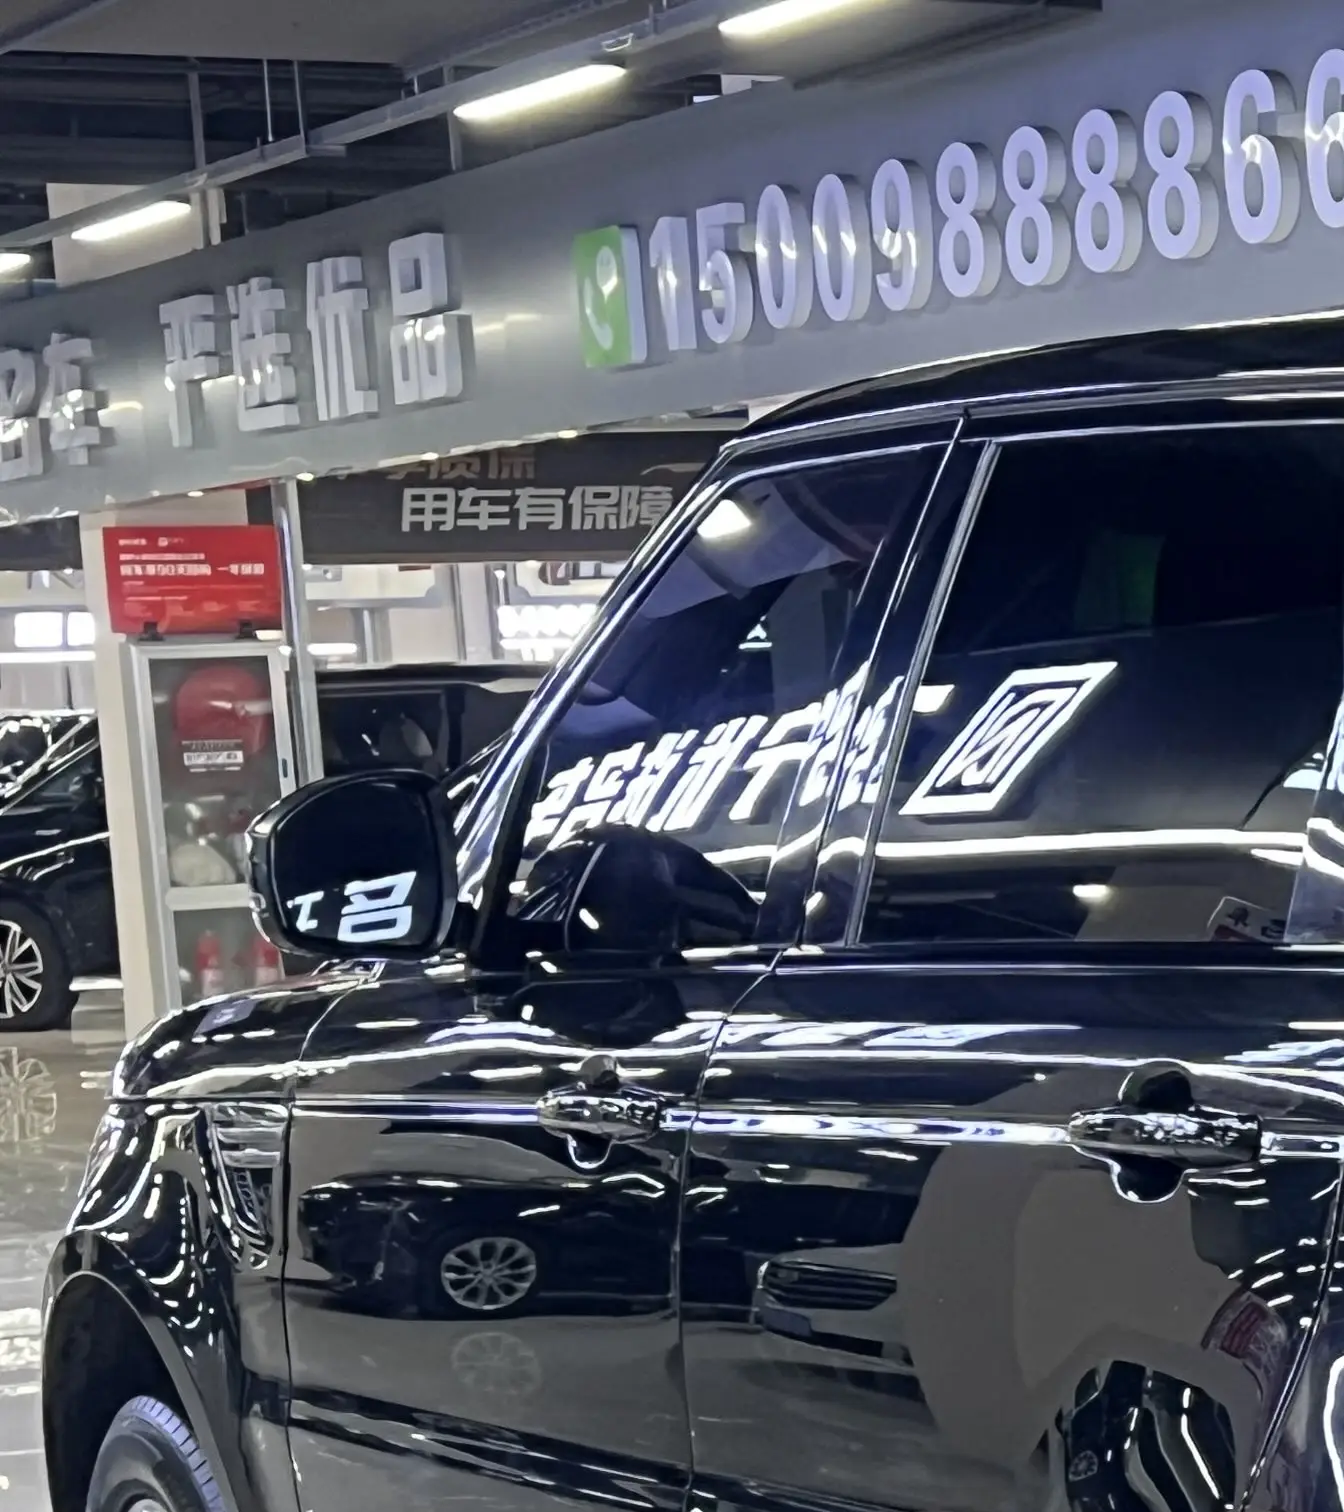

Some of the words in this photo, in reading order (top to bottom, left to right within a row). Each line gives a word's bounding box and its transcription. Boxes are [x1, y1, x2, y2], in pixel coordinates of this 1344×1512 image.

[160, 232, 470, 448] 严选优品
[401, 485, 674, 532] 用车有保障
